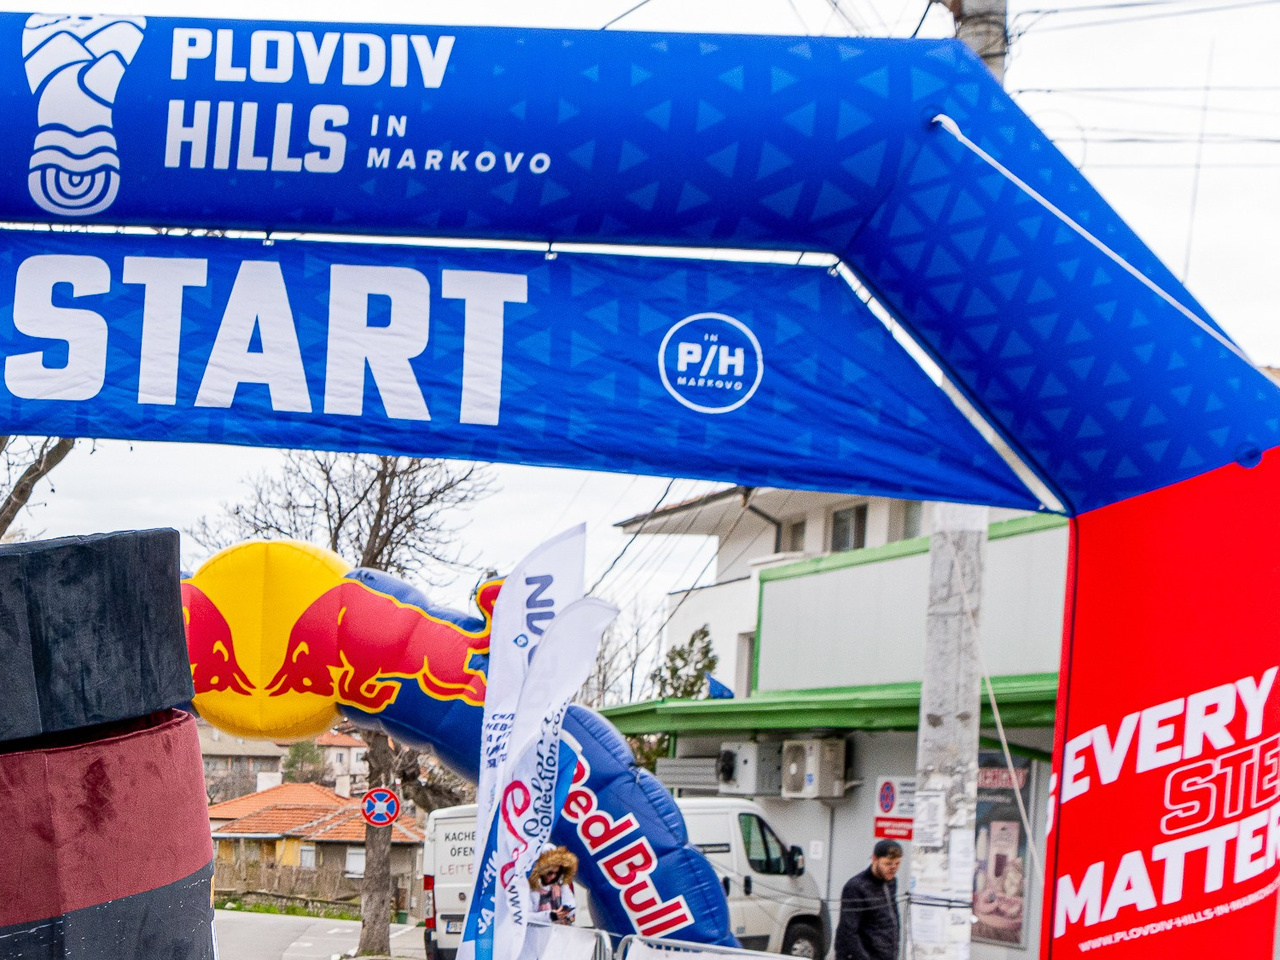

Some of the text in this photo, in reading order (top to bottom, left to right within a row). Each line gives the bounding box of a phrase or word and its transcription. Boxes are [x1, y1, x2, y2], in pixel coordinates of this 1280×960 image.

[170, 27, 456, 89] PLOVDIV
[164, 100, 349, 174] HILLS
[371, 115, 406, 137] IN
[367, 147, 551, 174] MARKOVO
[4, 254, 528, 425] START
[677, 342, 744, 376] P/H
[704, 333, 718, 342] IN
[677, 376, 743, 391] MARKOVO
[1060, 665, 1280, 804] EVERY
[602, 842, 689, 938] Bull
